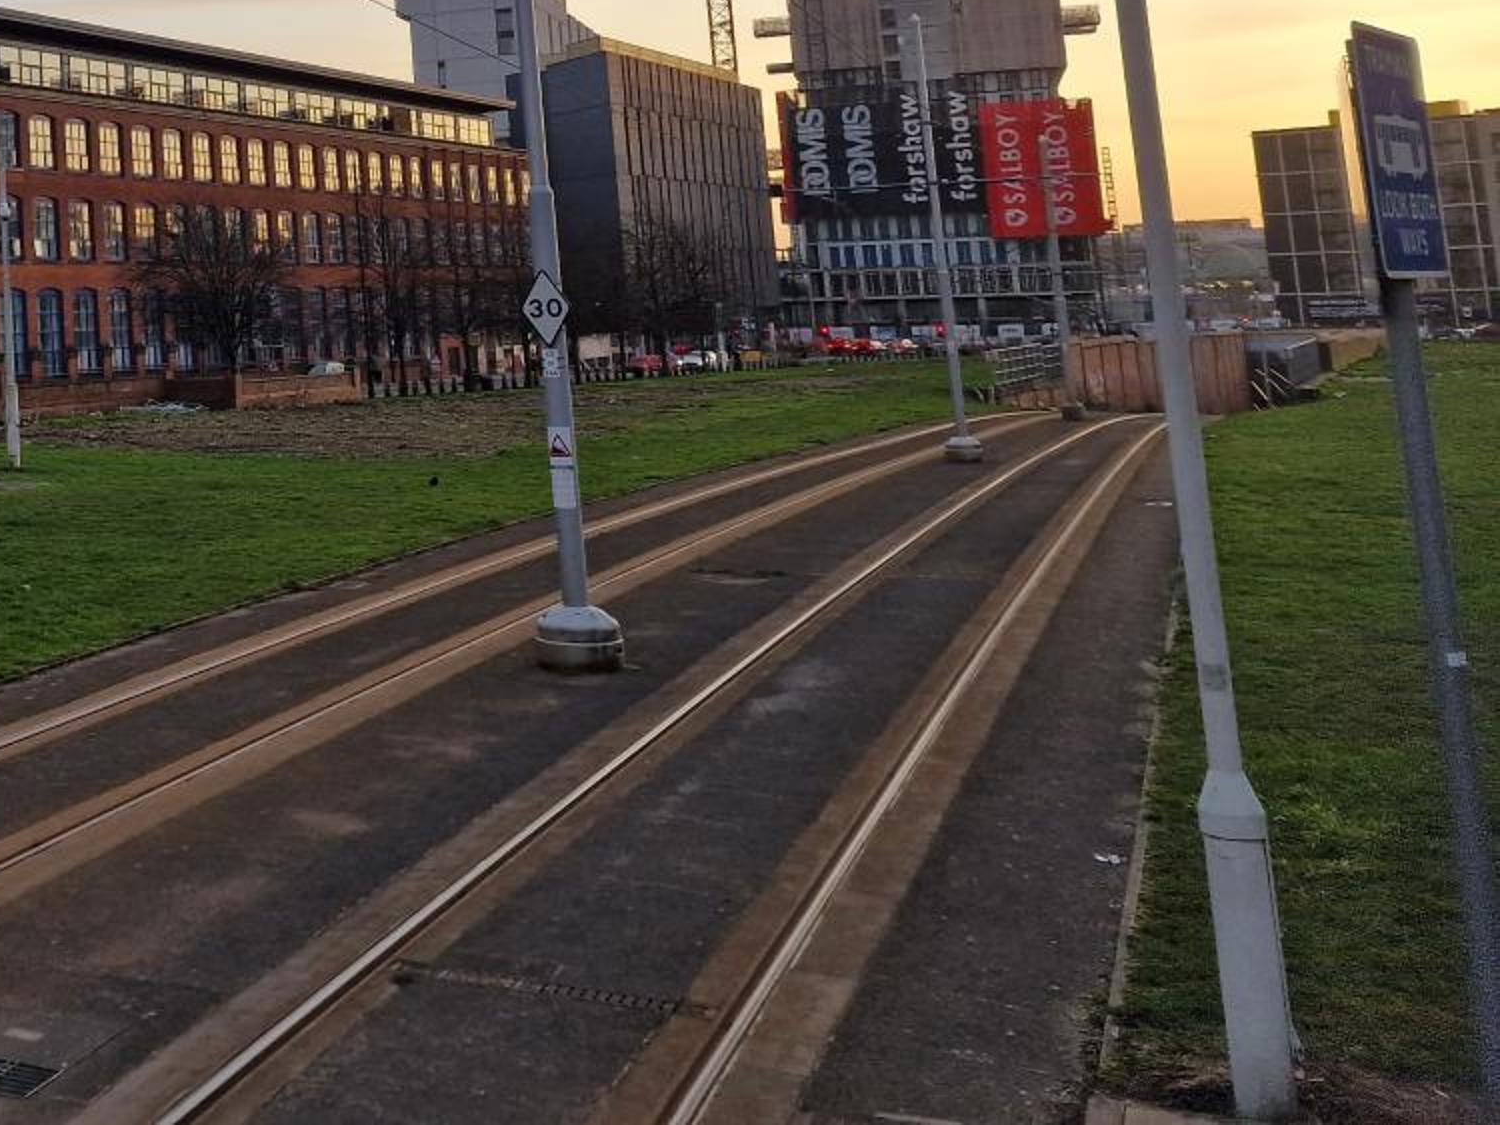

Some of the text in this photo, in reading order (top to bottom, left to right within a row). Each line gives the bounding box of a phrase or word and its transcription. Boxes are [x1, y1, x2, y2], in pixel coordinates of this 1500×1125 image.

[897, 93, 928, 204] forshaw
[946, 91, 977, 202] forshaw
[996, 113, 1028, 202] SALBOY
[1044, 111, 1076, 200] SALBOY
[529, 298, 563, 318] 30
